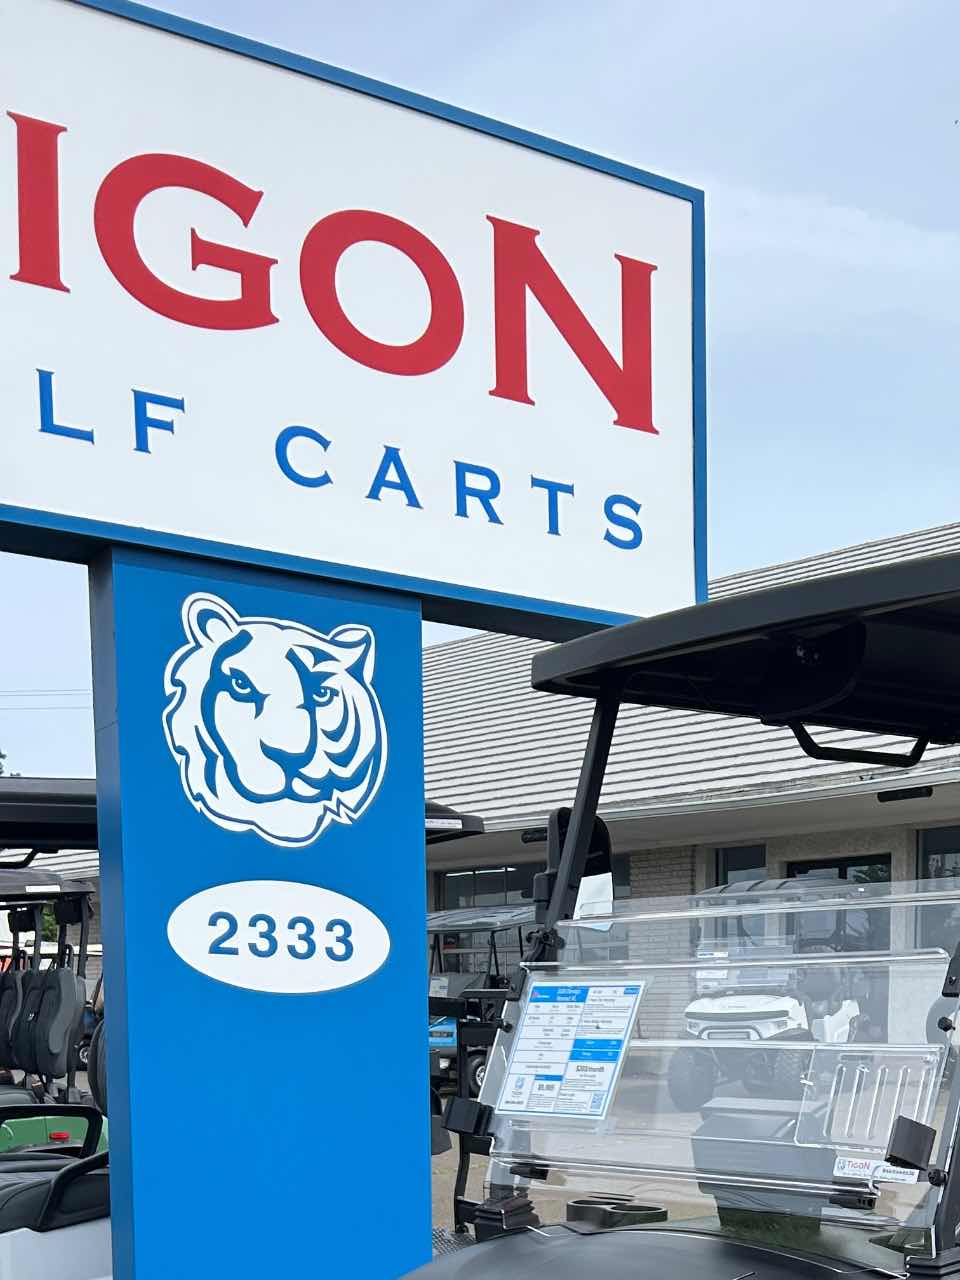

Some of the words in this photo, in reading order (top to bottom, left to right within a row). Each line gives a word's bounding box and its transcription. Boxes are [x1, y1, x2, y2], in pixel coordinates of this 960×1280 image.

[6, 110, 660, 435] IGON
[36, 368, 186, 455] LF
[274, 425, 644, 551] CARTS
[207, 911, 354, 962] 2333
